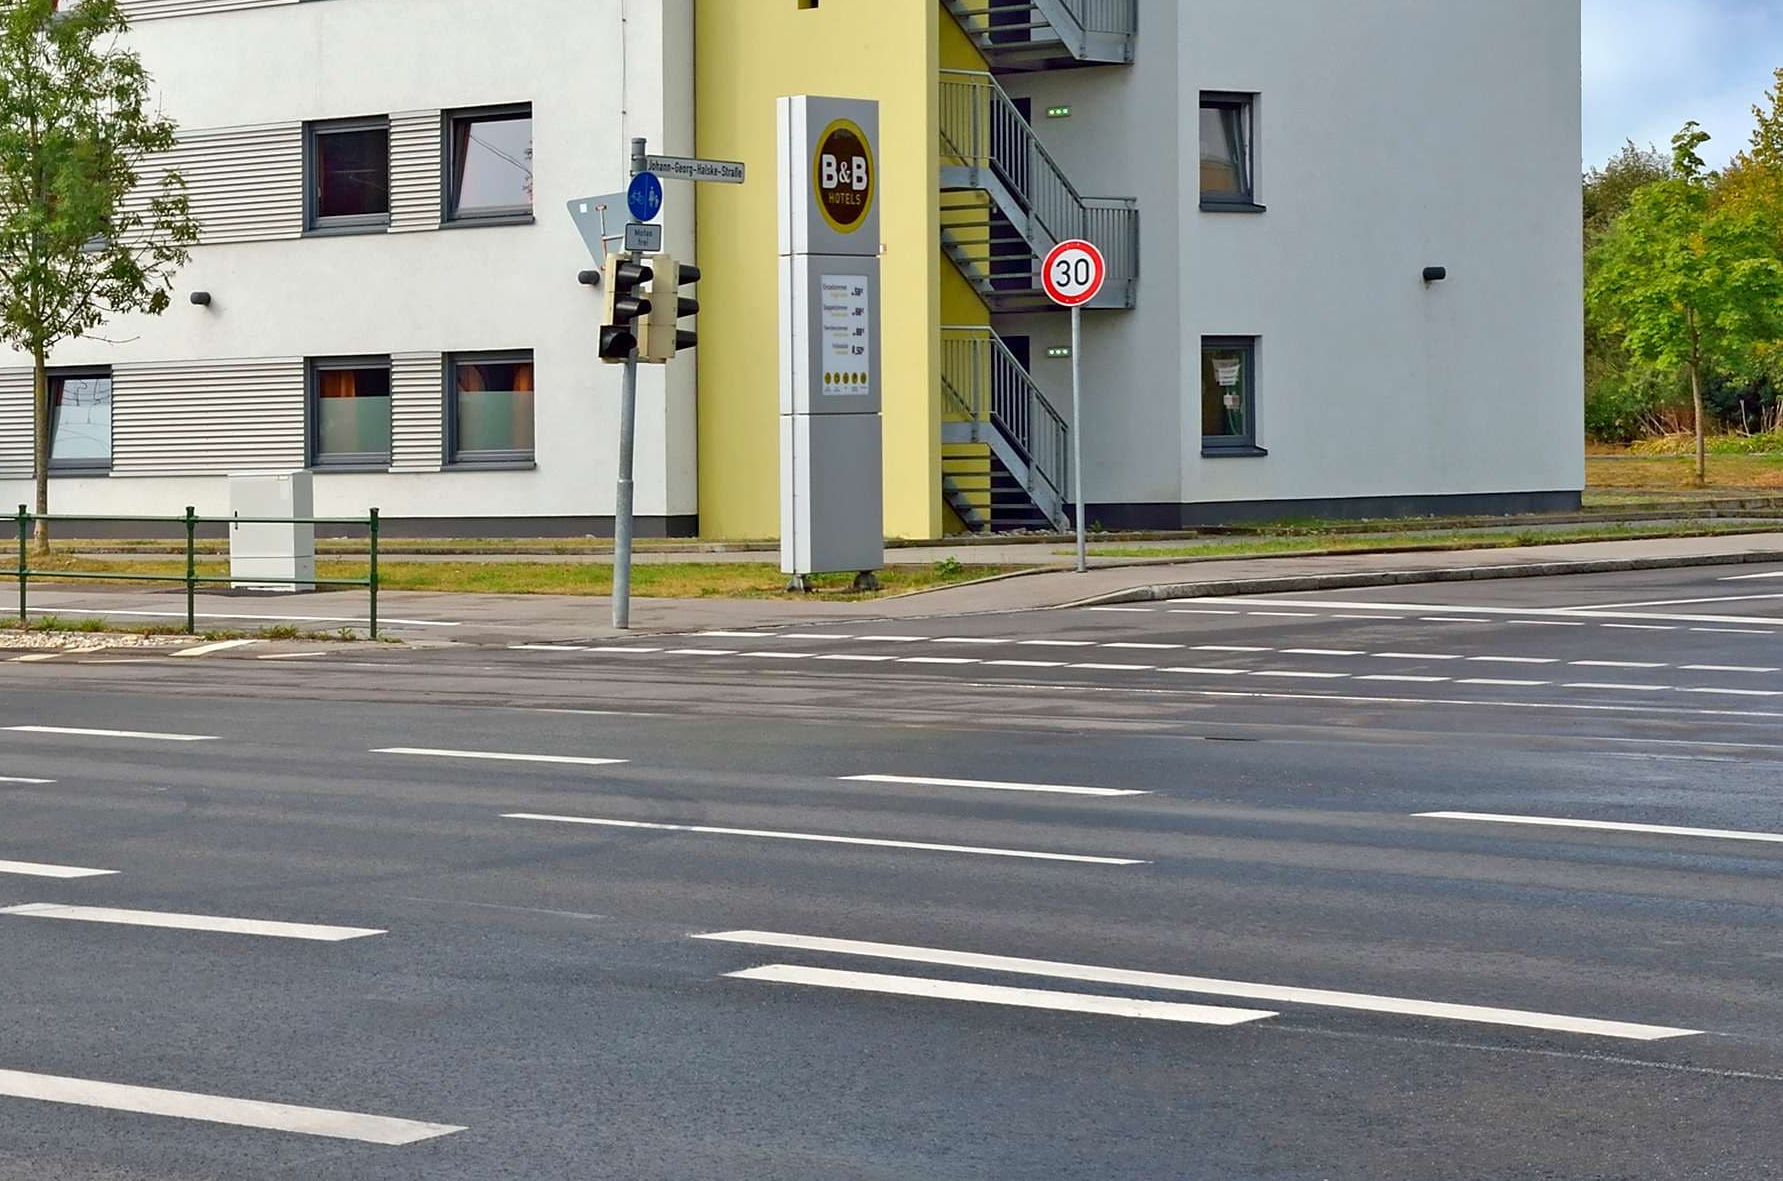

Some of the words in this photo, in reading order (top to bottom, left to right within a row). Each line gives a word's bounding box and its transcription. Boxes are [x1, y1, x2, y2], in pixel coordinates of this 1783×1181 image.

[648, 158, 742, 178] Johann-Georg-Halske-Straße
[822, 154, 867, 190] B&B
[828, 192, 861, 205] HOTELS
[1056, 258, 1089, 287] 30
